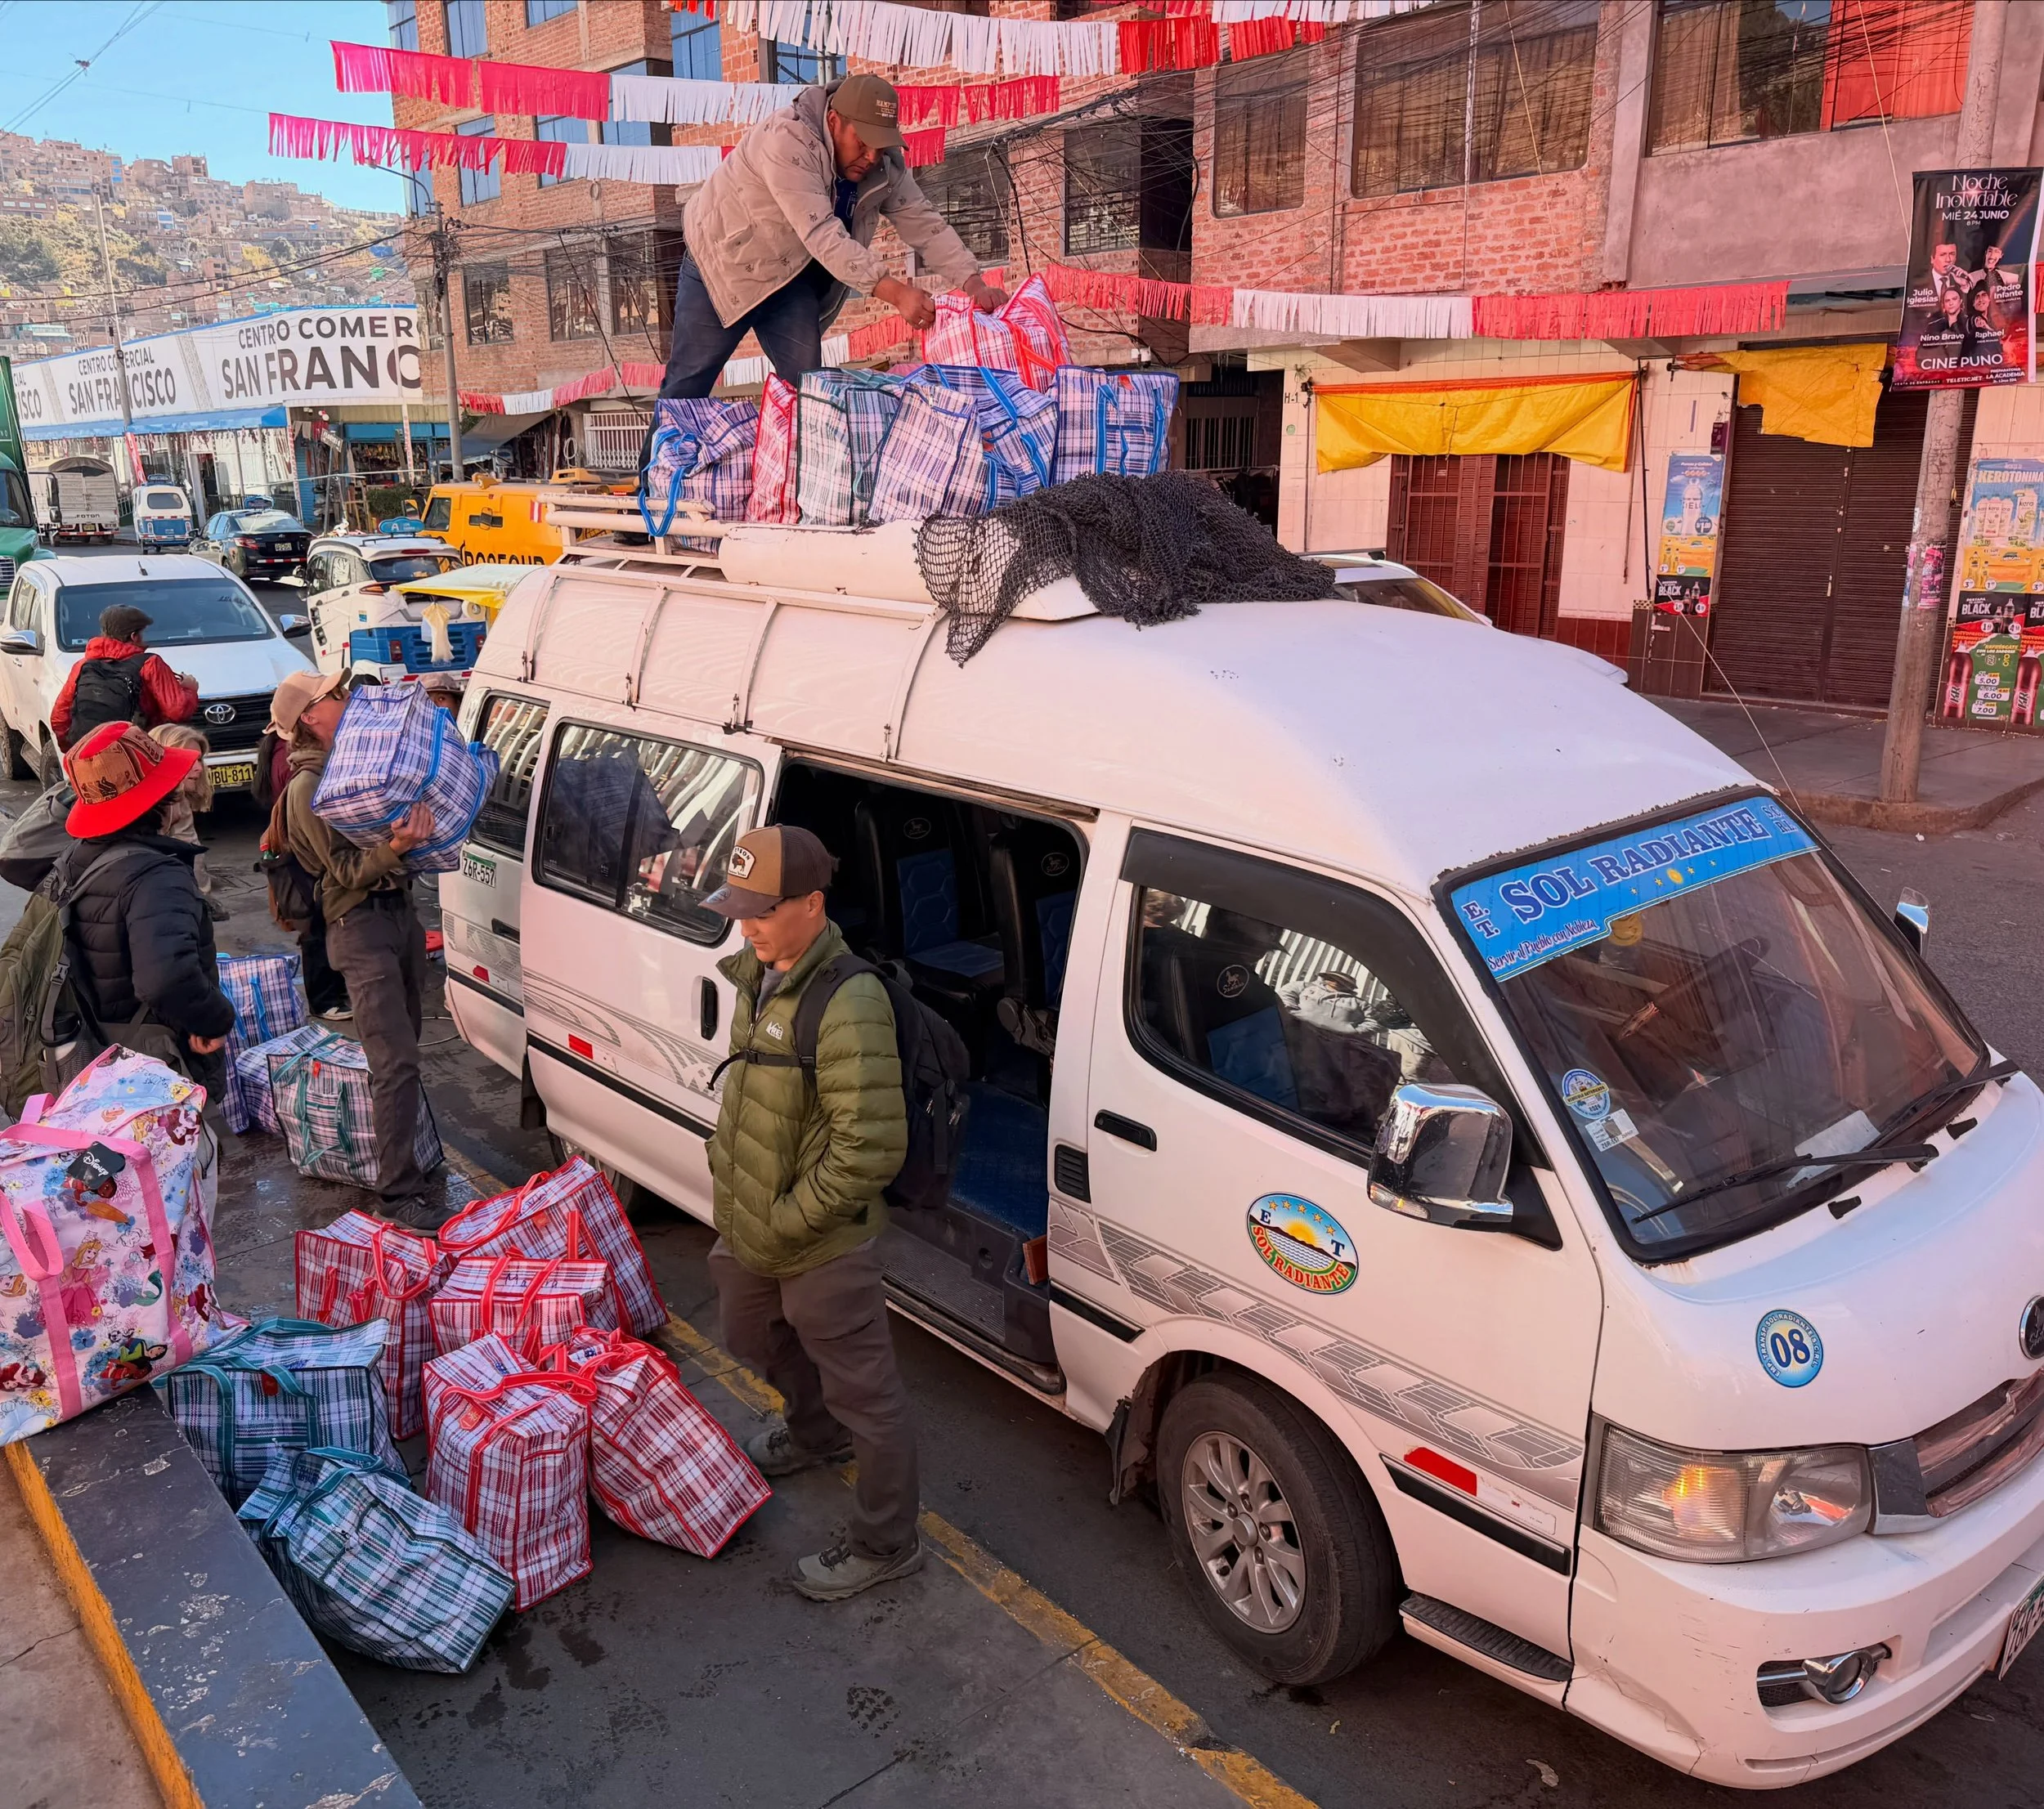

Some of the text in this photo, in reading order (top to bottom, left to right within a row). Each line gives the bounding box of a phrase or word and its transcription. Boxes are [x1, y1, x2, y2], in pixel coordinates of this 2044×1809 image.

[1952, 173, 2008, 190] Noche
[1935, 190, 2018, 208] Inolvidable
[1942, 210, 2009, 221] MIÉ 24 JUNIO
[1994, 290, 2024, 299] Infante
[1997, 284, 2021, 292] Pedro
[1907, 295, 1939, 304] Iglesias
[238, 316, 419, 349] CENTRO COMER
[1920, 334, 1940, 342] Nino
[1975, 329, 2005, 338] Raphael
[78, 356, 106, 375] CENTRO
[1921, 354, 2003, 370] CINE PUNO
[222, 355, 262, 400] SAN
[69, 379, 96, 414] SAN
[392, 523, 400, 532] A
[1659, 585, 1682, 596] BLACK
[1961, 603, 1992, 615] BLACK
[1951, 685, 1961, 703] KR
[2018, 692, 2028, 709] KR
[463, 858, 495, 886] Z6R-557
[1499, 807, 1772, 923] SOL RADIANTE
[1463, 902, 1490, 921] E.
[1474, 920, 1500, 938] T.
[1487, 951, 1516, 970] Servir
[1522, 934, 1553, 953] Pueblo
[1553, 929, 1566, 944] con
[1564, 919, 1600, 936] Nobleza
[83, 1151, 109, 1176] Disney
[1260, 1209, 1345, 1256] E T
[1253, 1226, 1350, 1290] SOL RADIANTE
[1765, 1316, 1778, 1327] SOL
[1778, 1314, 1813, 1337] RADIANTE
[1770, 1328, 1810, 1368] 08
